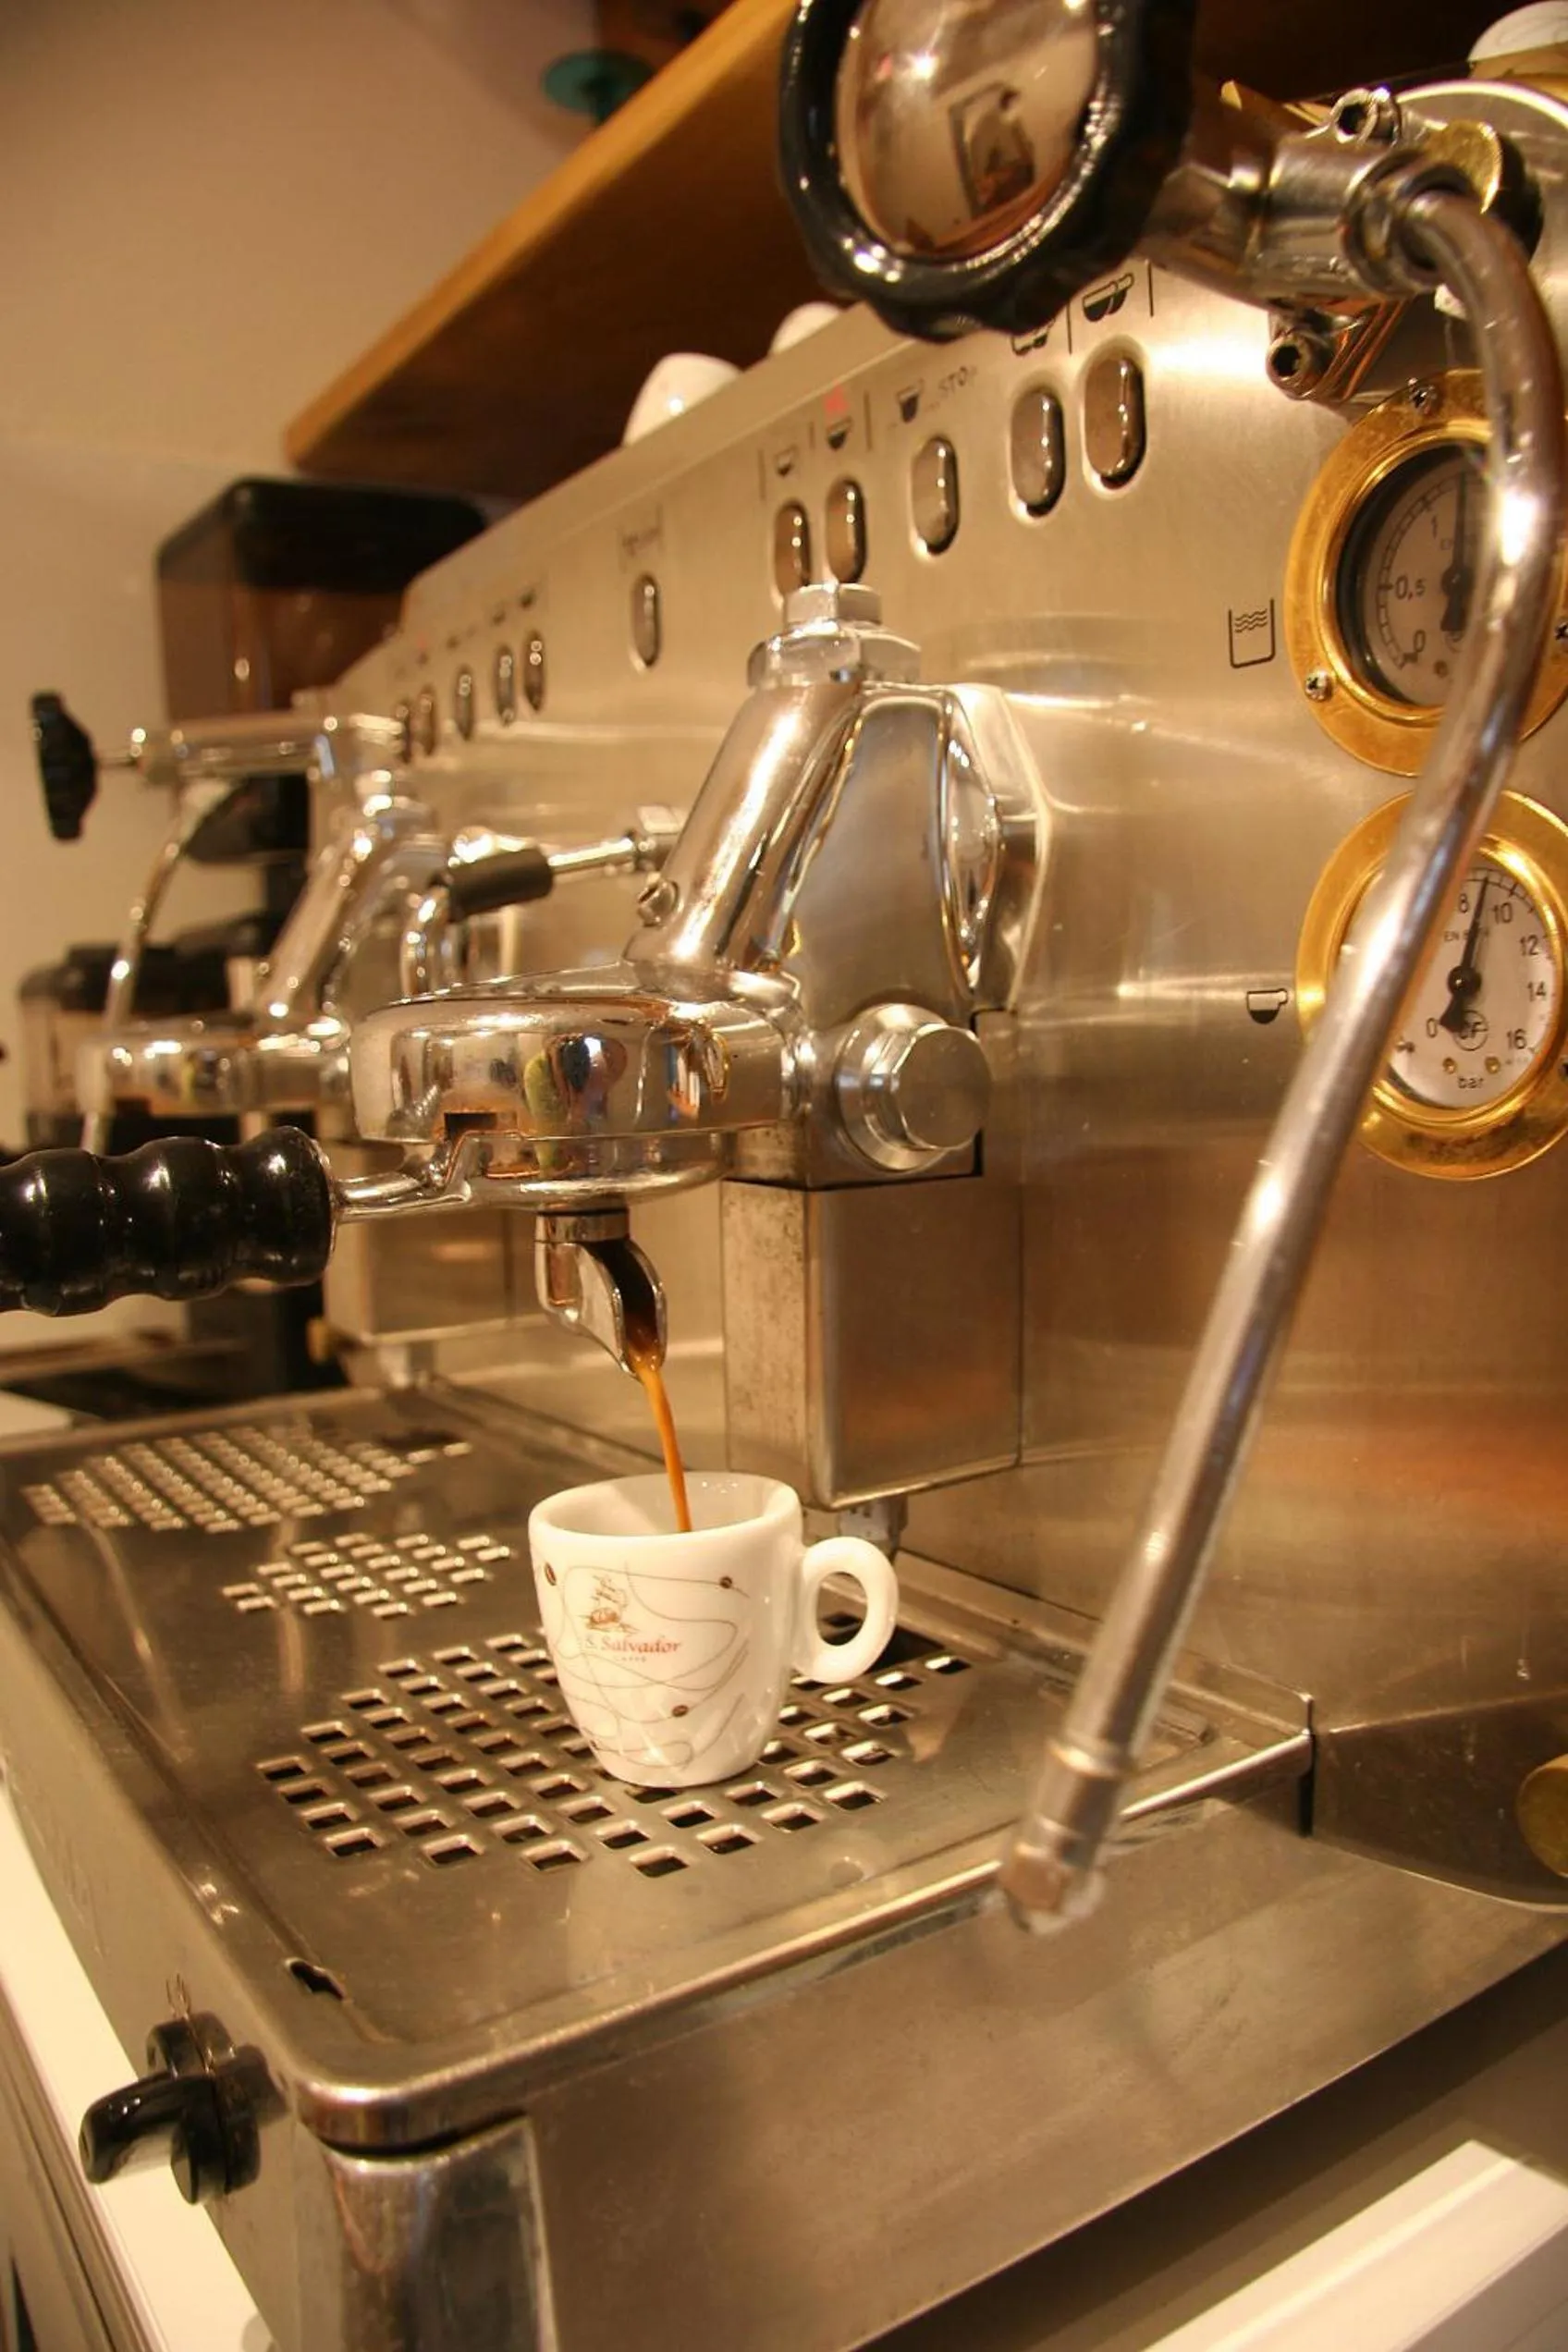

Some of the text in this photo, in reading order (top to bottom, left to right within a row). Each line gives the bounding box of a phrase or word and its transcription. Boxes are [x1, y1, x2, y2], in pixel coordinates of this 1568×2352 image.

[1394, 574, 1427, 601] 0,5
[1413, 629, 1427, 653] 0
[1459, 892, 1470, 914] 8
[1491, 901, 1513, 924] 10
[1519, 933, 1539, 957] 12
[1526, 980, 1547, 1001] 14
[1426, 1017, 1439, 1038] 0
[1505, 1027, 1528, 1050] 16
[1457, 1075, 1485, 1090] bar
[601, 1634, 681, 1654] Salvador
